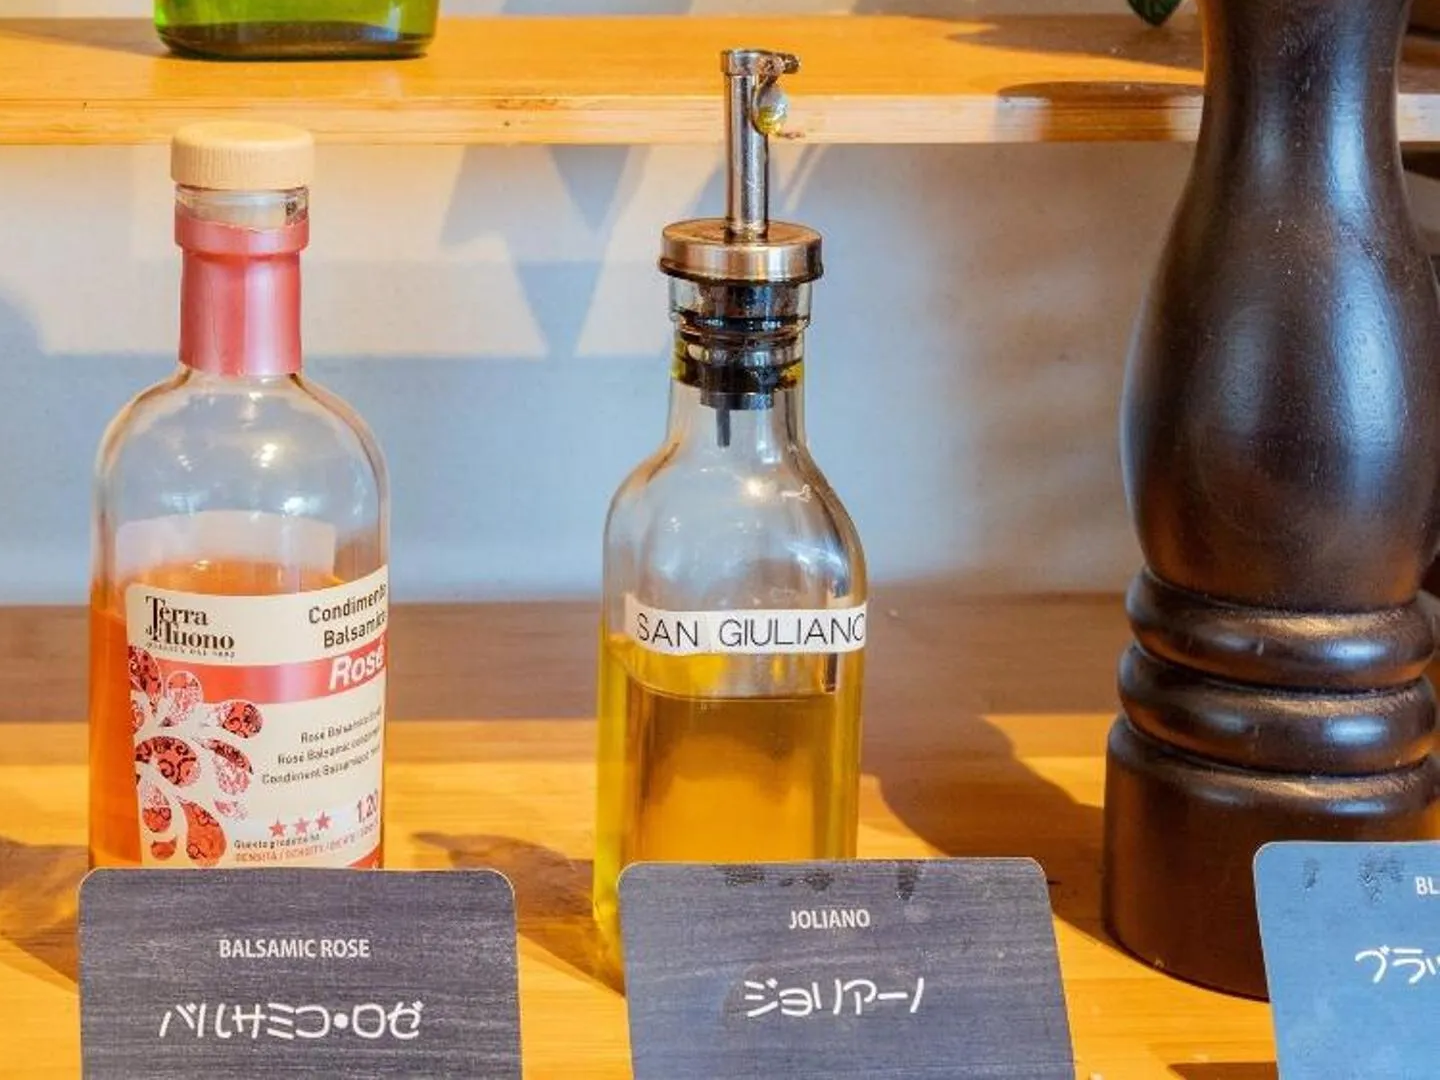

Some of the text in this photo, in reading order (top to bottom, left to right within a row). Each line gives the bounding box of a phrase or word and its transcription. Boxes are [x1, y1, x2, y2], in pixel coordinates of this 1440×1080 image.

[145, 595, 209, 641] Terra
[635, 612, 699, 648] SAN
[788, 908, 871, 930] JOLIANO
[219, 938, 372, 959] BALSAMIC ROSE
[743, 976, 925, 1019] ジョリアーノ
